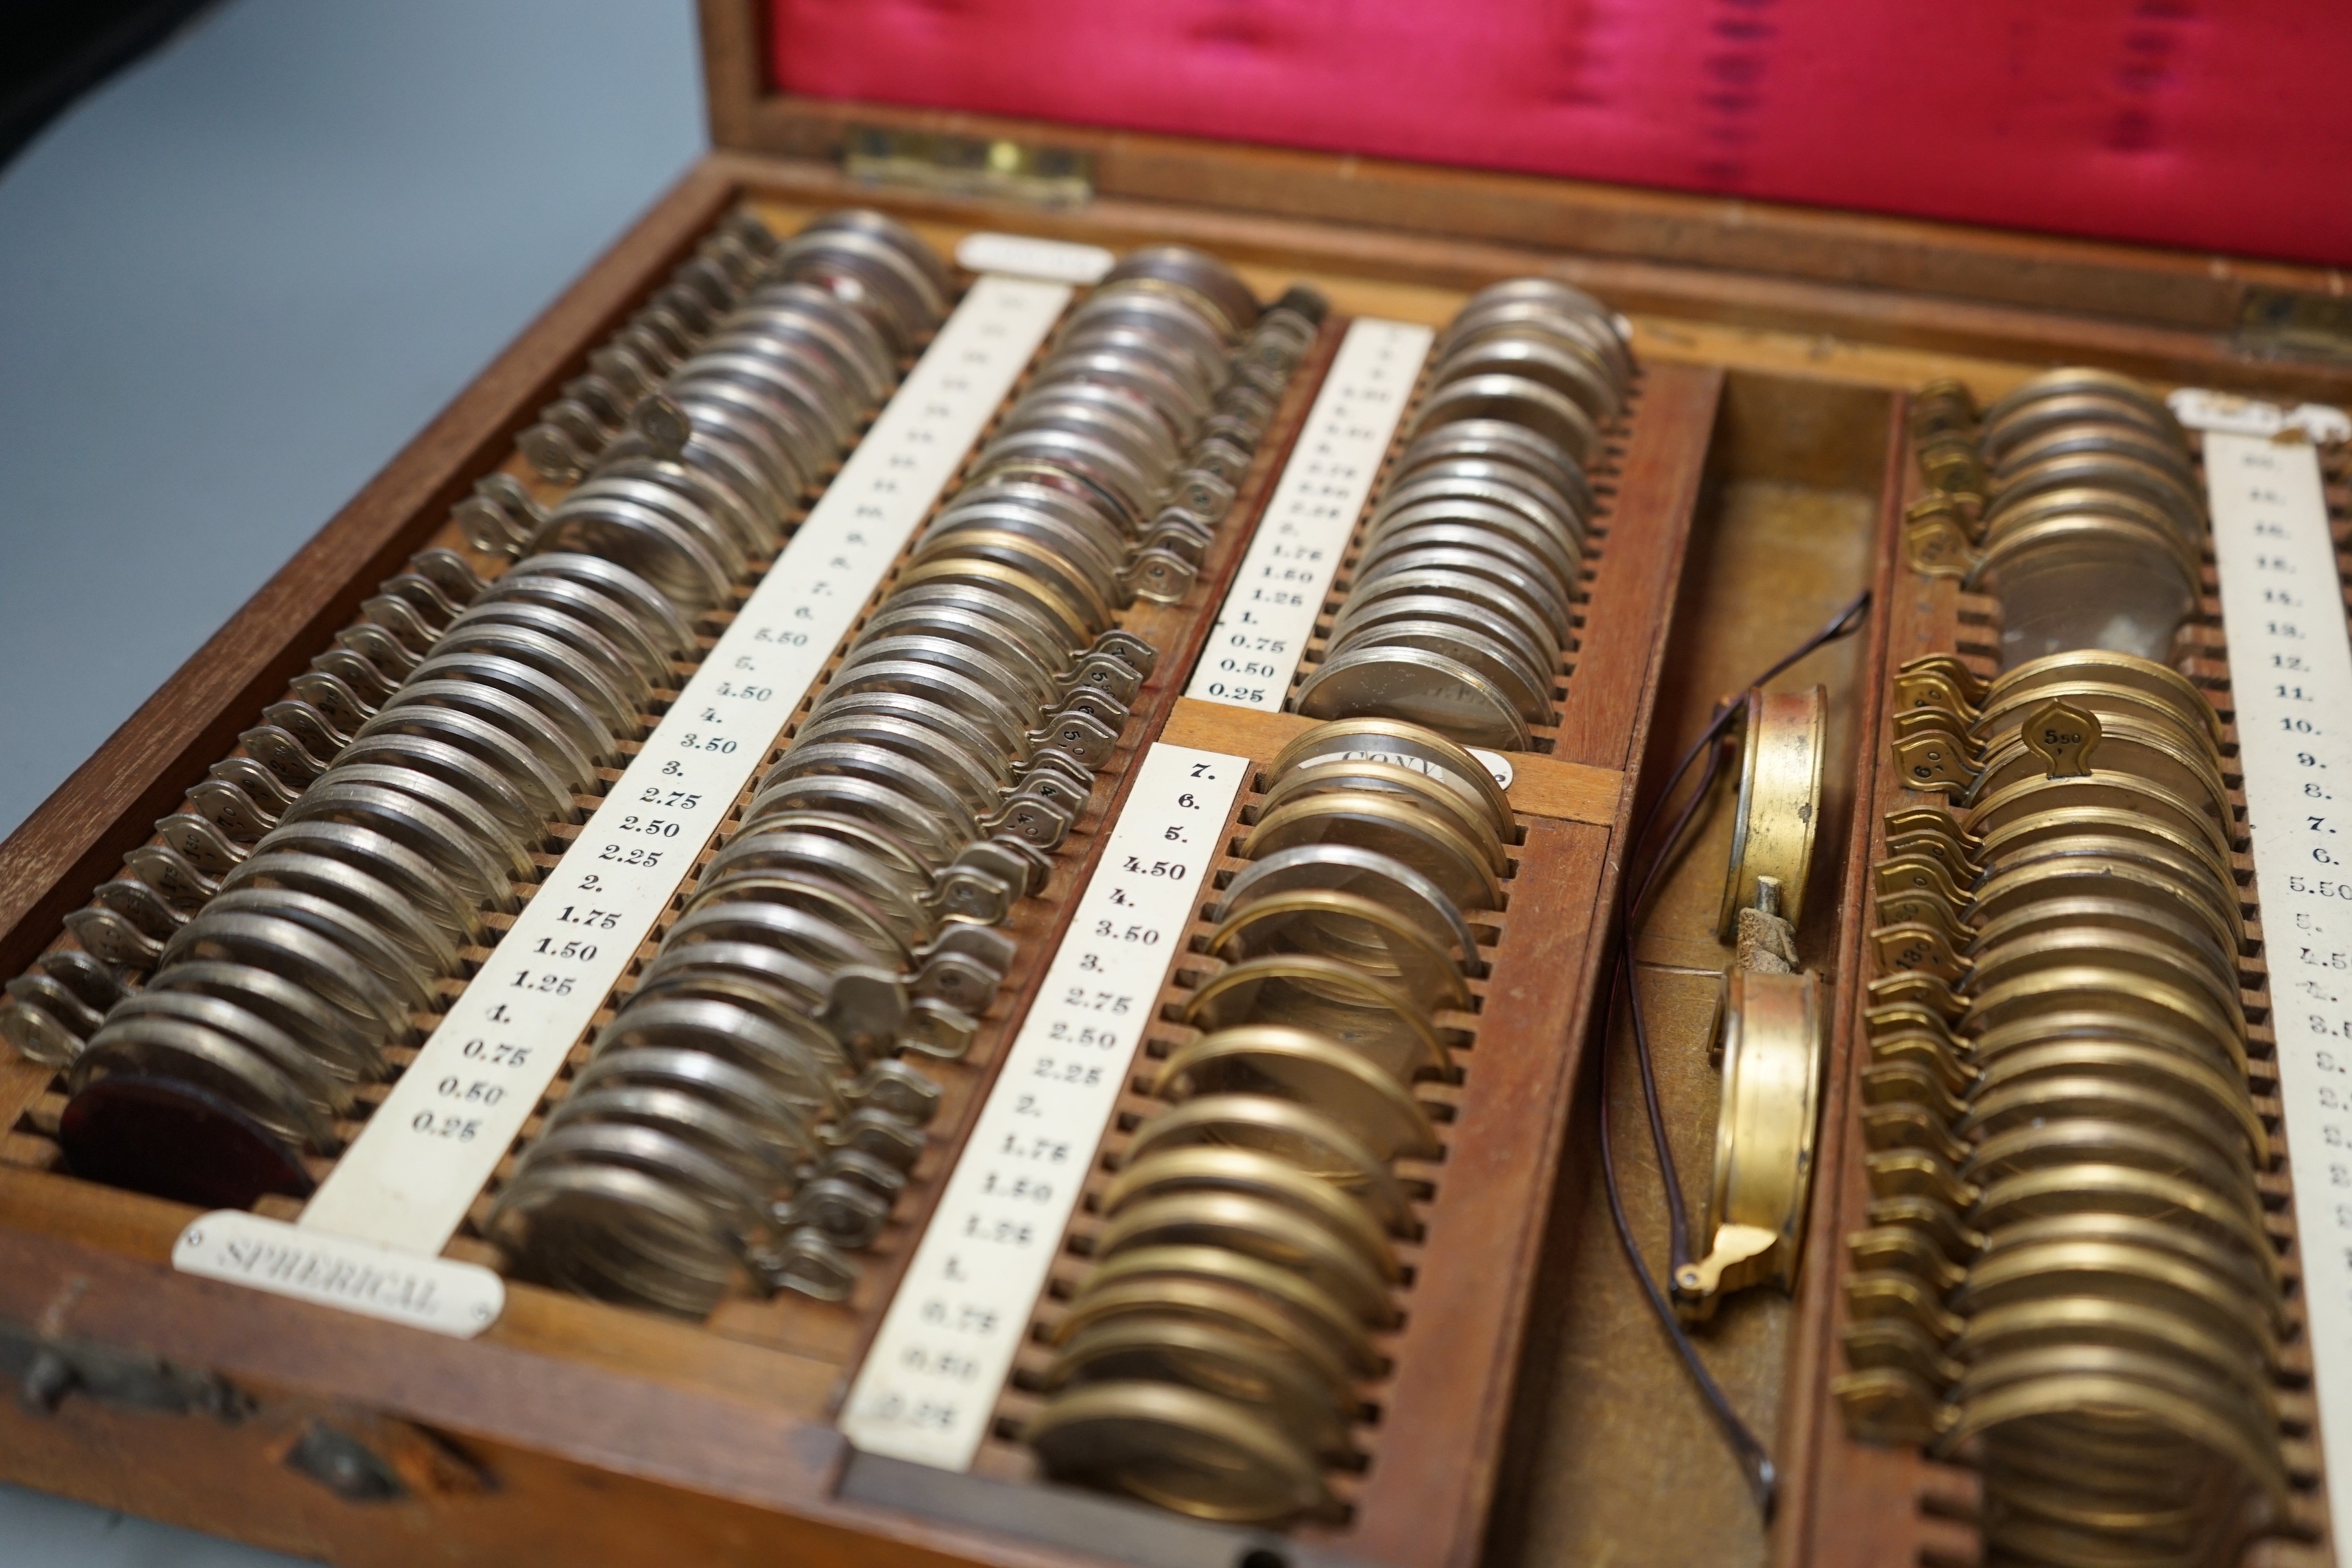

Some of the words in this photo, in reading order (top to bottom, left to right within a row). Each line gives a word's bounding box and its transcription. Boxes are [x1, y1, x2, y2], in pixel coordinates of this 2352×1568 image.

[1273, 543, 1322, 561] 1.75
[1262, 565, 1314, 583] 1.50
[1252, 588, 1303, 606] 1.25
[1241, 610, 1258, 625] 1.
[754, 627, 808, 647] 5.50
[1230, 634, 1287, 653] 0.75
[735, 655, 755, 671] 5.
[1219, 658, 1275, 678] 0.50
[2271, 653, 2309, 672] 12.
[717, 682, 772, 702] 4.50
[1207, 682, 1266, 702] 0.25
[2275, 684, 2313, 702] 11.
[700, 707, 723, 724] 4.
[2281, 717, 2322, 735] 10.
[680, 733, 737, 754] 3.50
[661, 760, 684, 777] 3.
[2296, 752, 2327, 770] 9.
[1190, 763, 1216, 781] 7.
[639, 787, 702, 809] 2.75
[1178, 793, 1200, 810] 6.
[2303, 783, 2332, 800] 8.
[619, 816, 680, 838] 2.50
[1164, 826, 1188, 844] 5.
[2306, 816, 2337, 834] 7.
[597, 844, 663, 868] 2.25
[2312, 848, 2340, 866] 6.
[1122, 855, 1187, 881] 4.50
[578, 874, 603, 893] 2.
[2290, 876, 2352, 901] 5.50
[1108, 888, 1135, 907] 4.
[556, 905, 622, 929] 1.75
[1095, 919, 1160, 945] 3.50
[533, 937, 598, 962] 1.50
[2300, 947, 2352, 969] 4.5
[1079, 953, 1104, 973] 3.
[510, 969, 576, 996] 1.25
[1065, 988, 1132, 1014] 2.75
[486, 1003, 511, 1024] 1.
[1049, 1022, 1117, 1049] 2.50
[462, 1038, 532, 1067] 0.75
[1034, 1058, 1103, 1085] 2.25
[438, 1076, 506, 1106] 0.50
[1015, 1095, 1042, 1117] 2.
[411, 1110, 482, 1141] 0.25
[1002, 1133, 1070, 1162] 1.75
[984, 1172, 1053, 1202] 1.50
[965, 1214, 1034, 1245] 1.25
[218, 1238, 440, 1316] SPHERICAL
